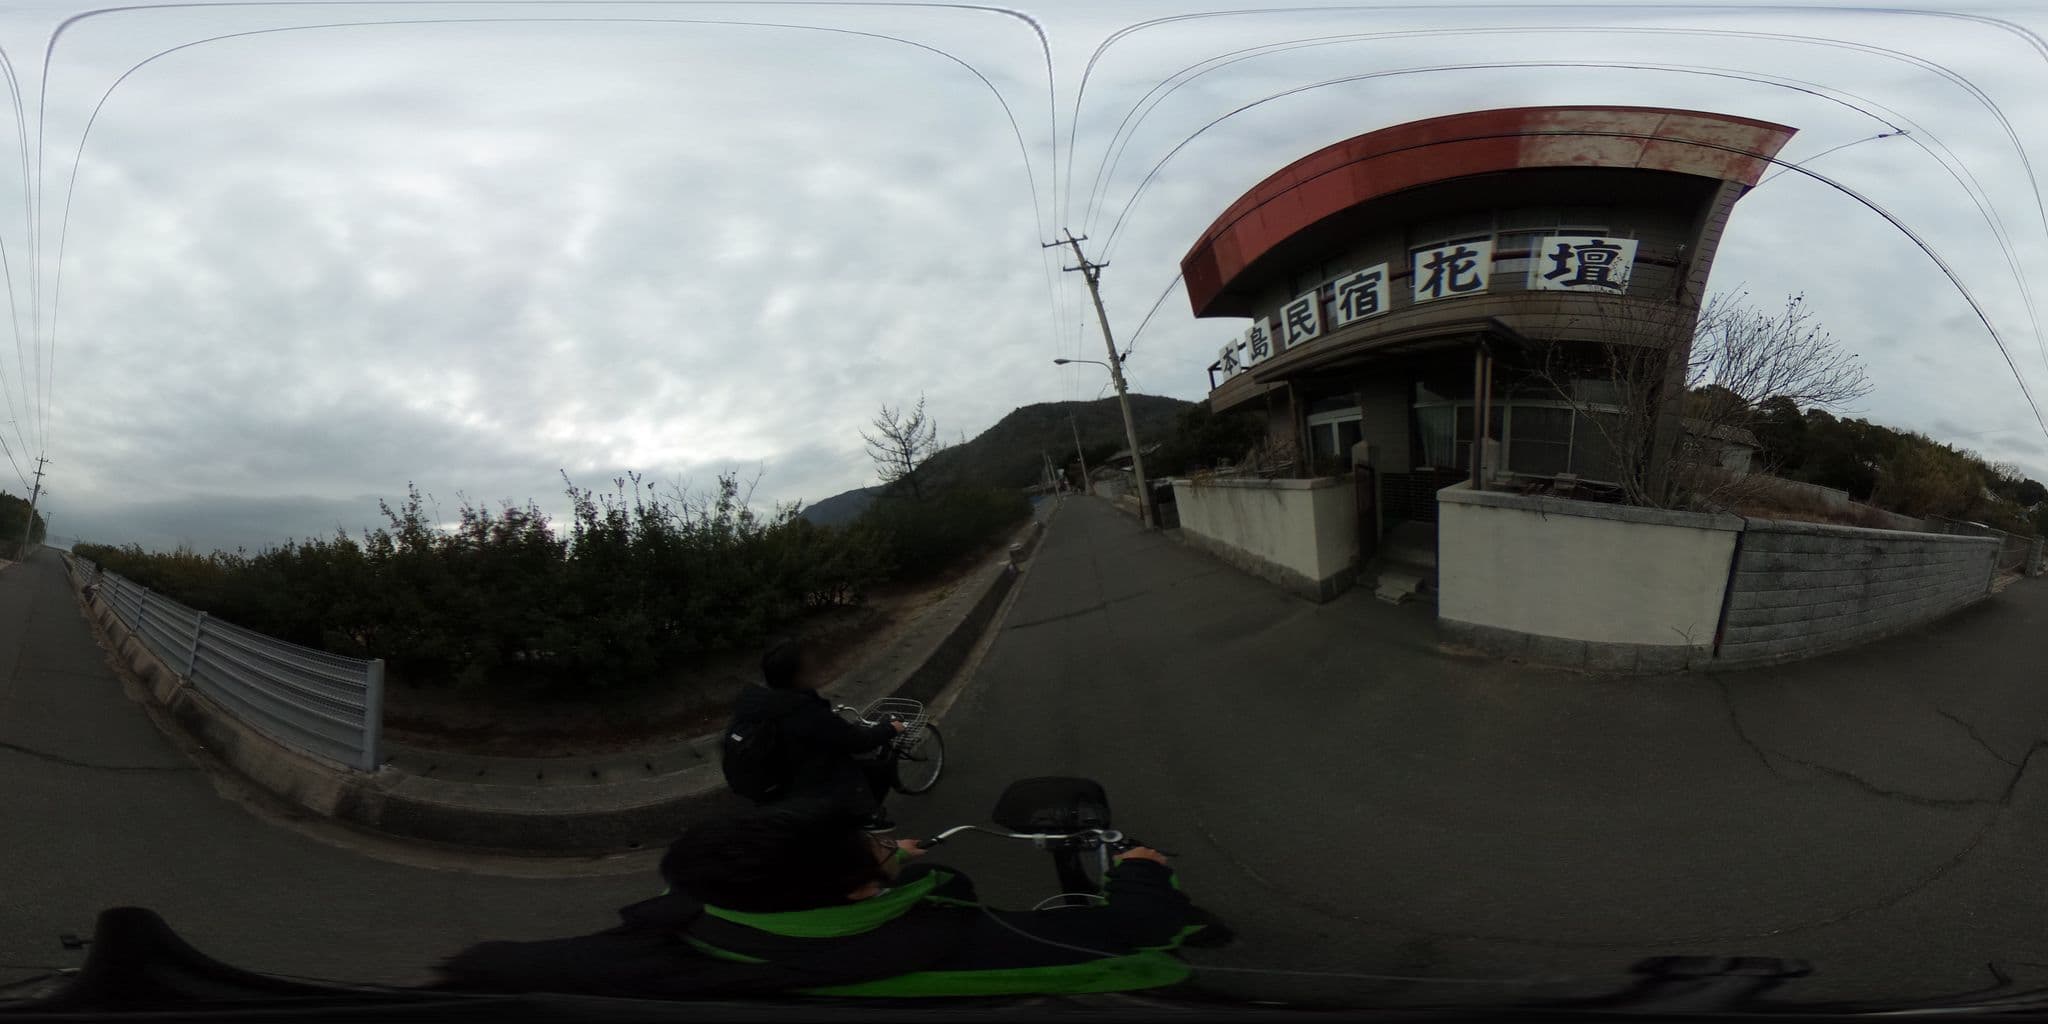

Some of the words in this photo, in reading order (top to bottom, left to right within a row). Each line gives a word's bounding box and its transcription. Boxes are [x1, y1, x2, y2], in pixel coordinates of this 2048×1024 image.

[1223, 239, 1623, 375] 本島民宿花壇
